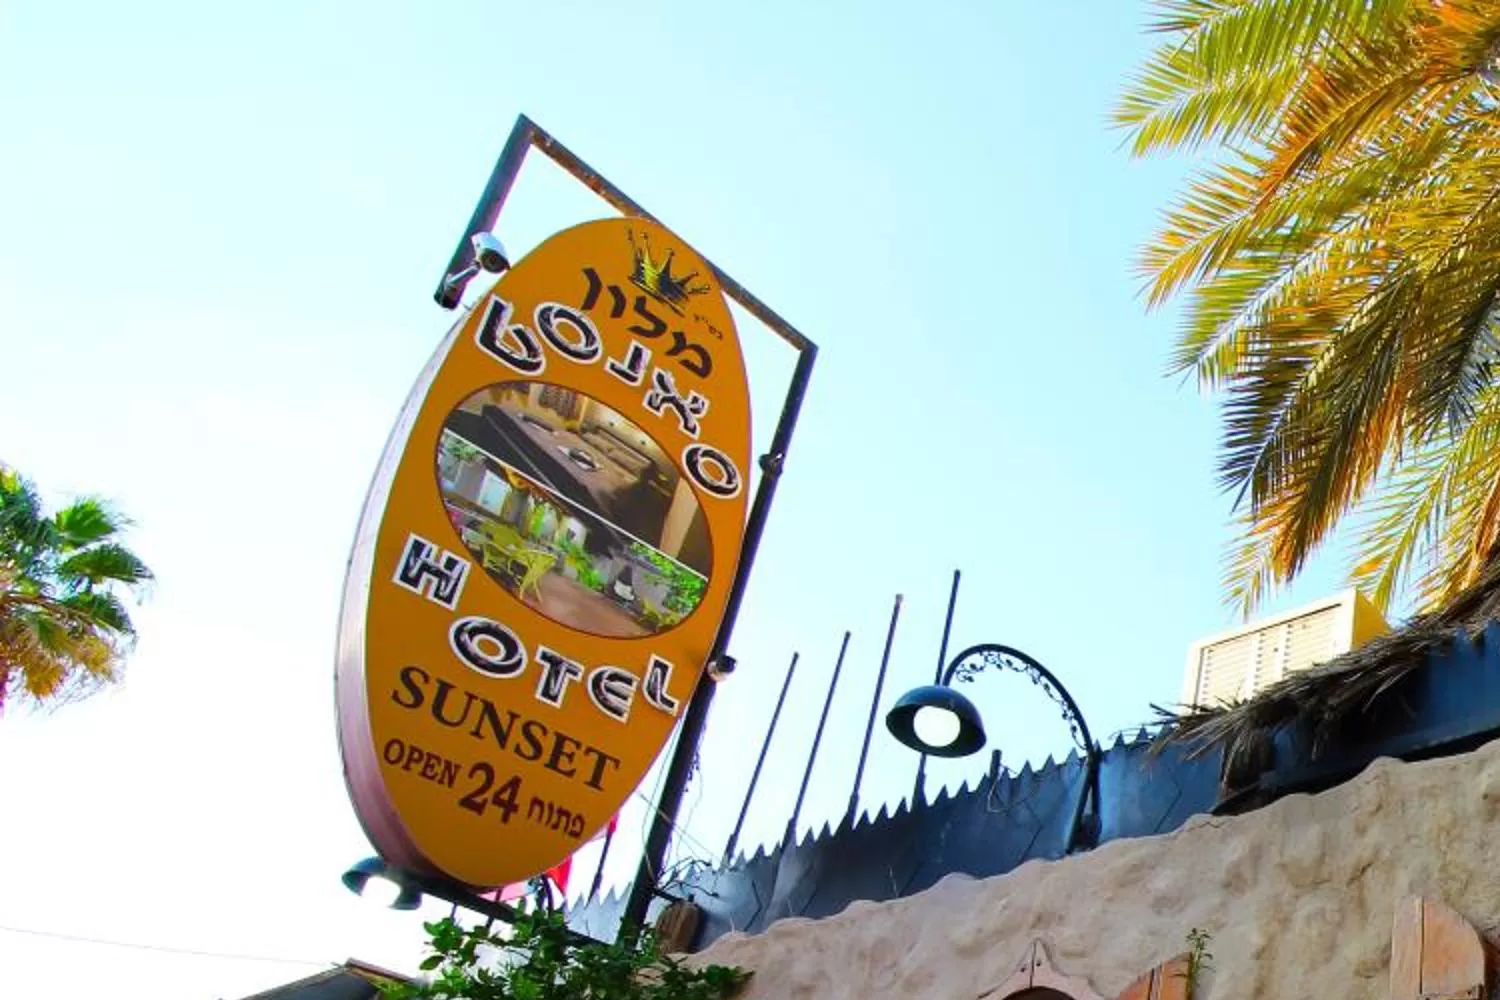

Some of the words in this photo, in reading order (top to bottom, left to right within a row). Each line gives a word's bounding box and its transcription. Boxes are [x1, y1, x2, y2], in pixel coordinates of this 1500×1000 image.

[581, 267, 713, 380] מלון
[475, 293, 742, 499] סאנסט
[392, 532, 679, 724] HOTEL
[383, 738, 463, 789] OPEN
[458, 761, 523, 825] 24
[526, 796, 586, 839] פתוח
[391, 665, 621, 792] SUNSET
